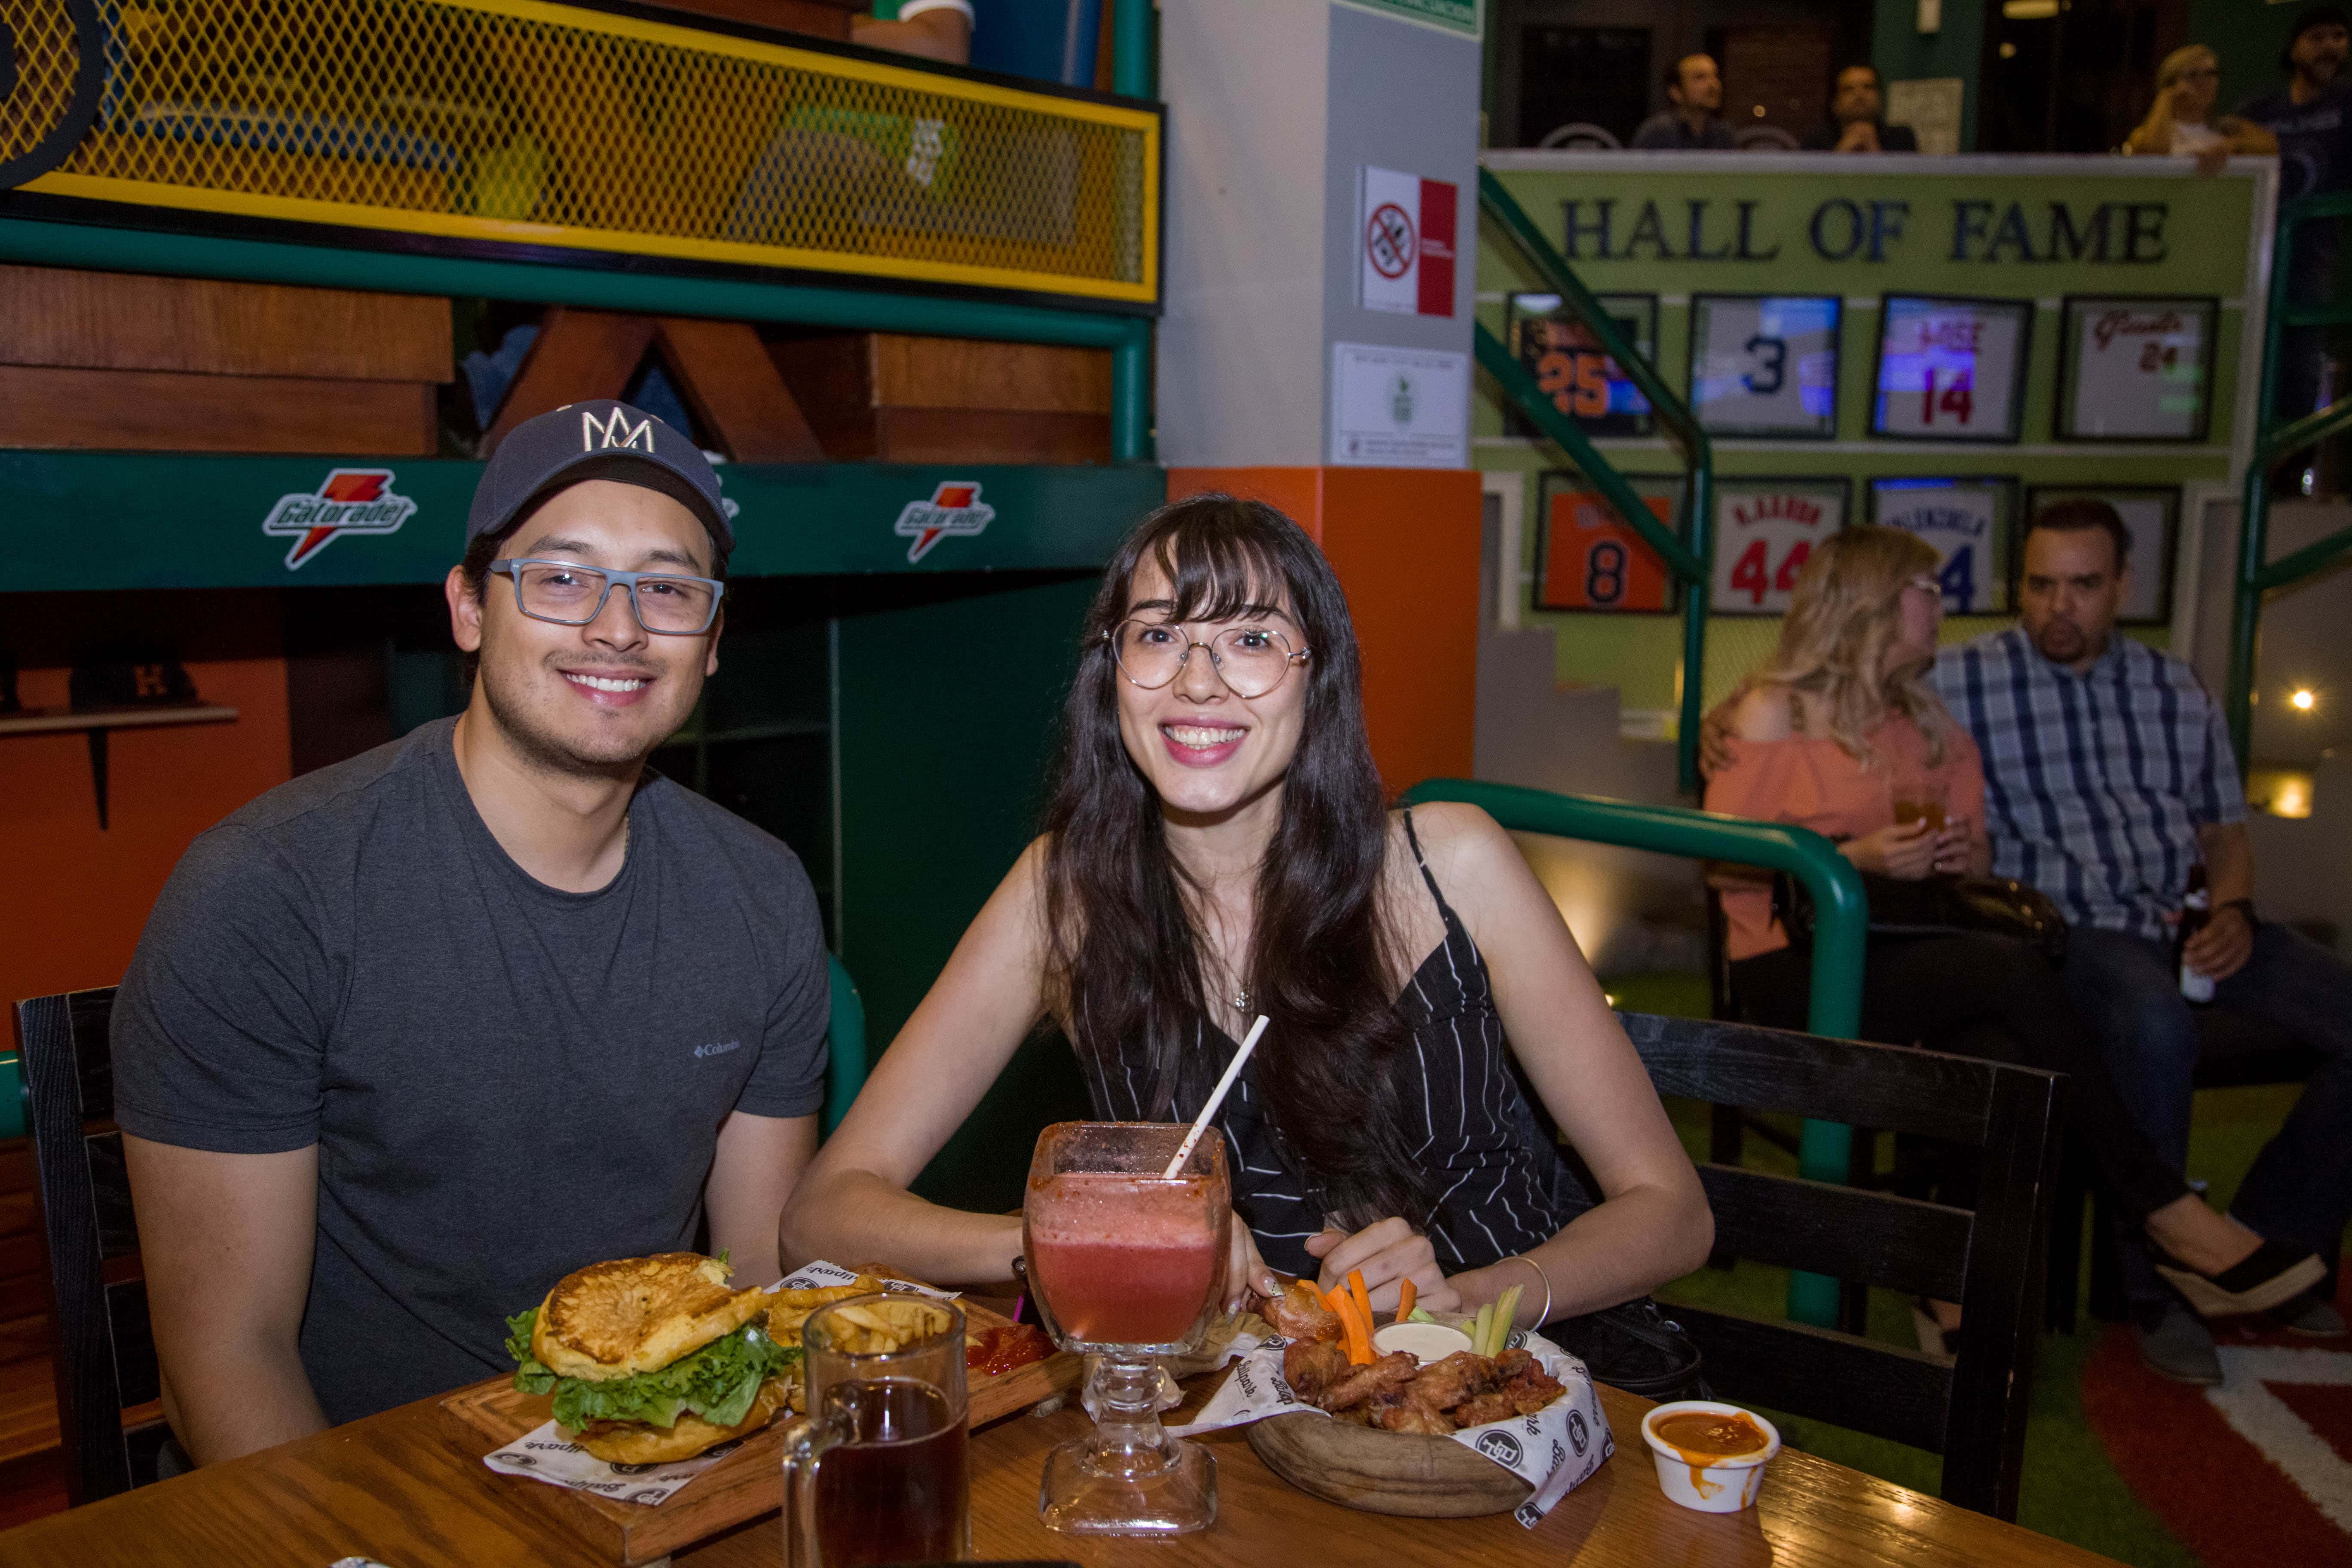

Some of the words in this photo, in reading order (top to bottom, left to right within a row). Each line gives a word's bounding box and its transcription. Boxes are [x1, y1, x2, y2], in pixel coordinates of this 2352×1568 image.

[1559, 199, 1782, 260] HALL
[1809, 198, 1911, 263] OF
[1951, 199, 2170, 263] FAME
[1536, 351, 1608, 418] 25
[1741, 334, 1787, 395] 3
[1921, 367, 1974, 424] 14
[277, 499, 401, 523] Gatorade
[1586, 539, 1626, 606] 8
